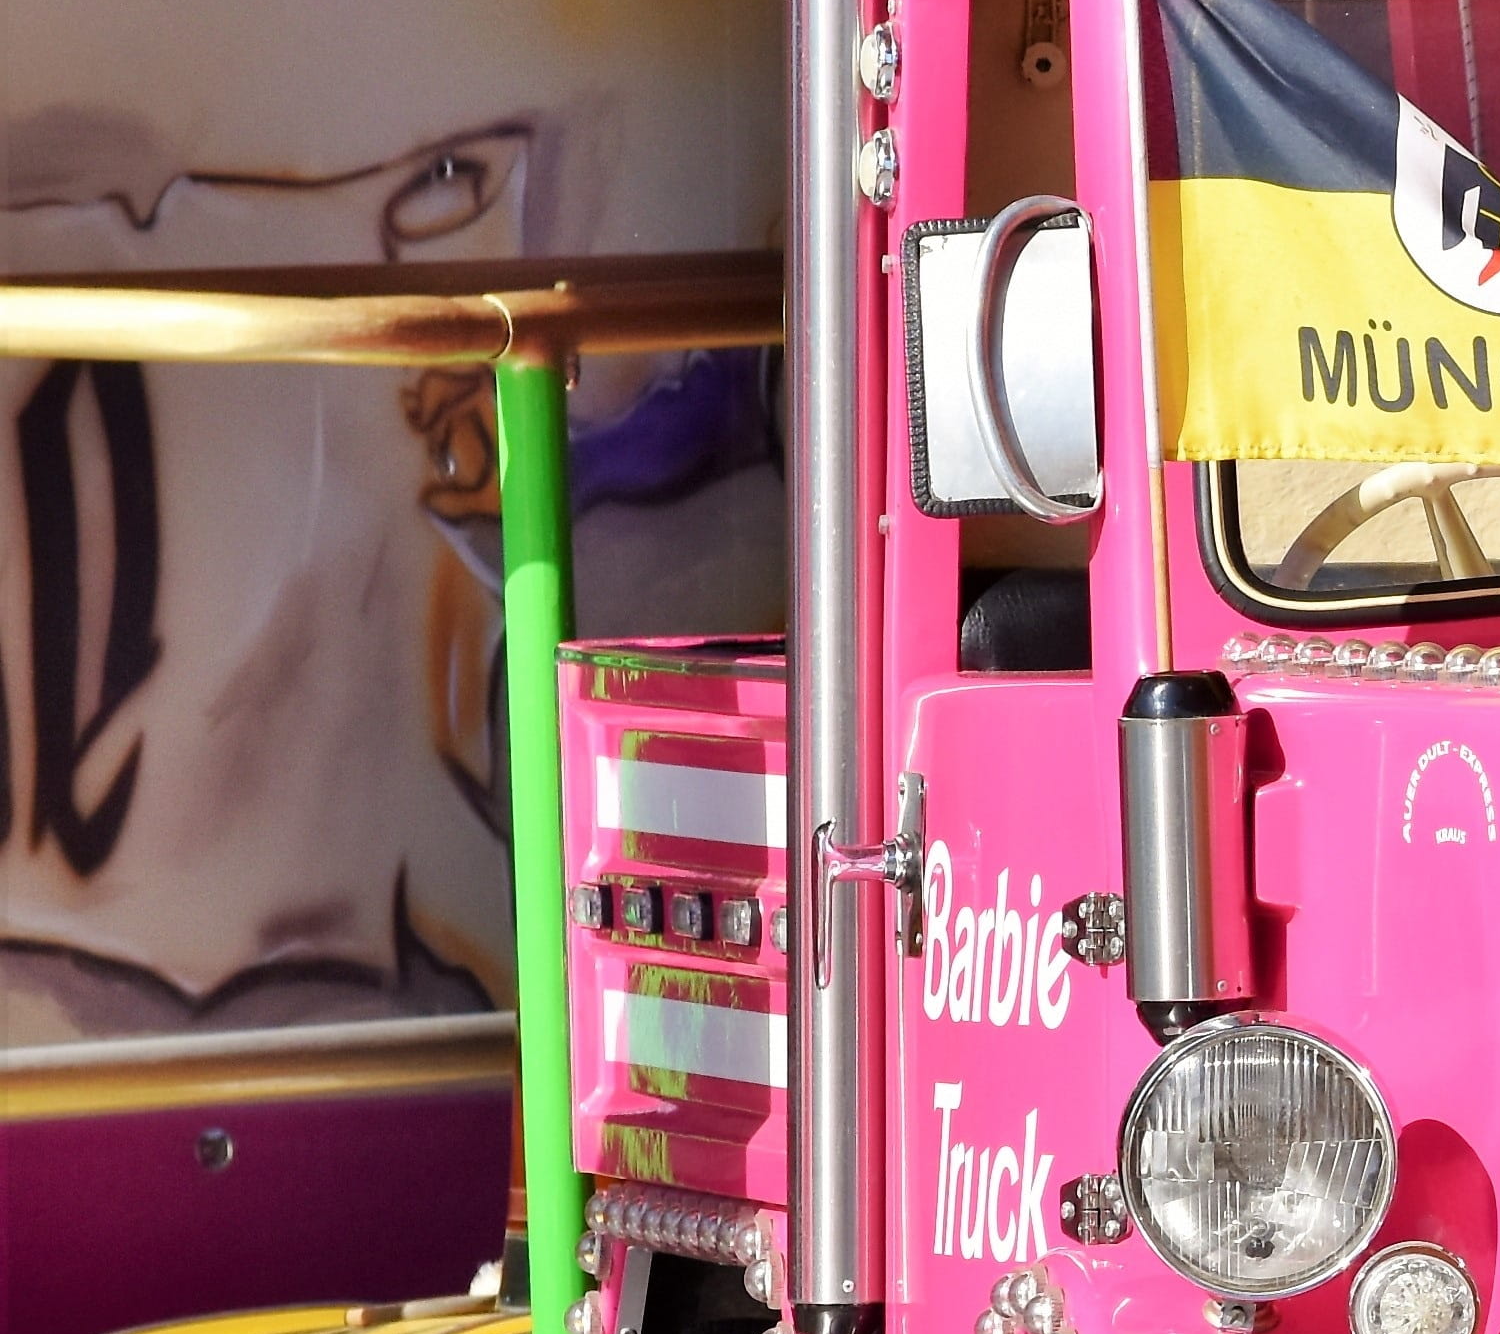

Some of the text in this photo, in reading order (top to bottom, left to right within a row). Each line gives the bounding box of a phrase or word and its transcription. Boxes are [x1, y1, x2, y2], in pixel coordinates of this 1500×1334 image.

[1435, 827, 1467, 845] KRAUS
[922, 839, 1073, 1030] Barbie
[933, 1080, 1055, 1265] Truck
